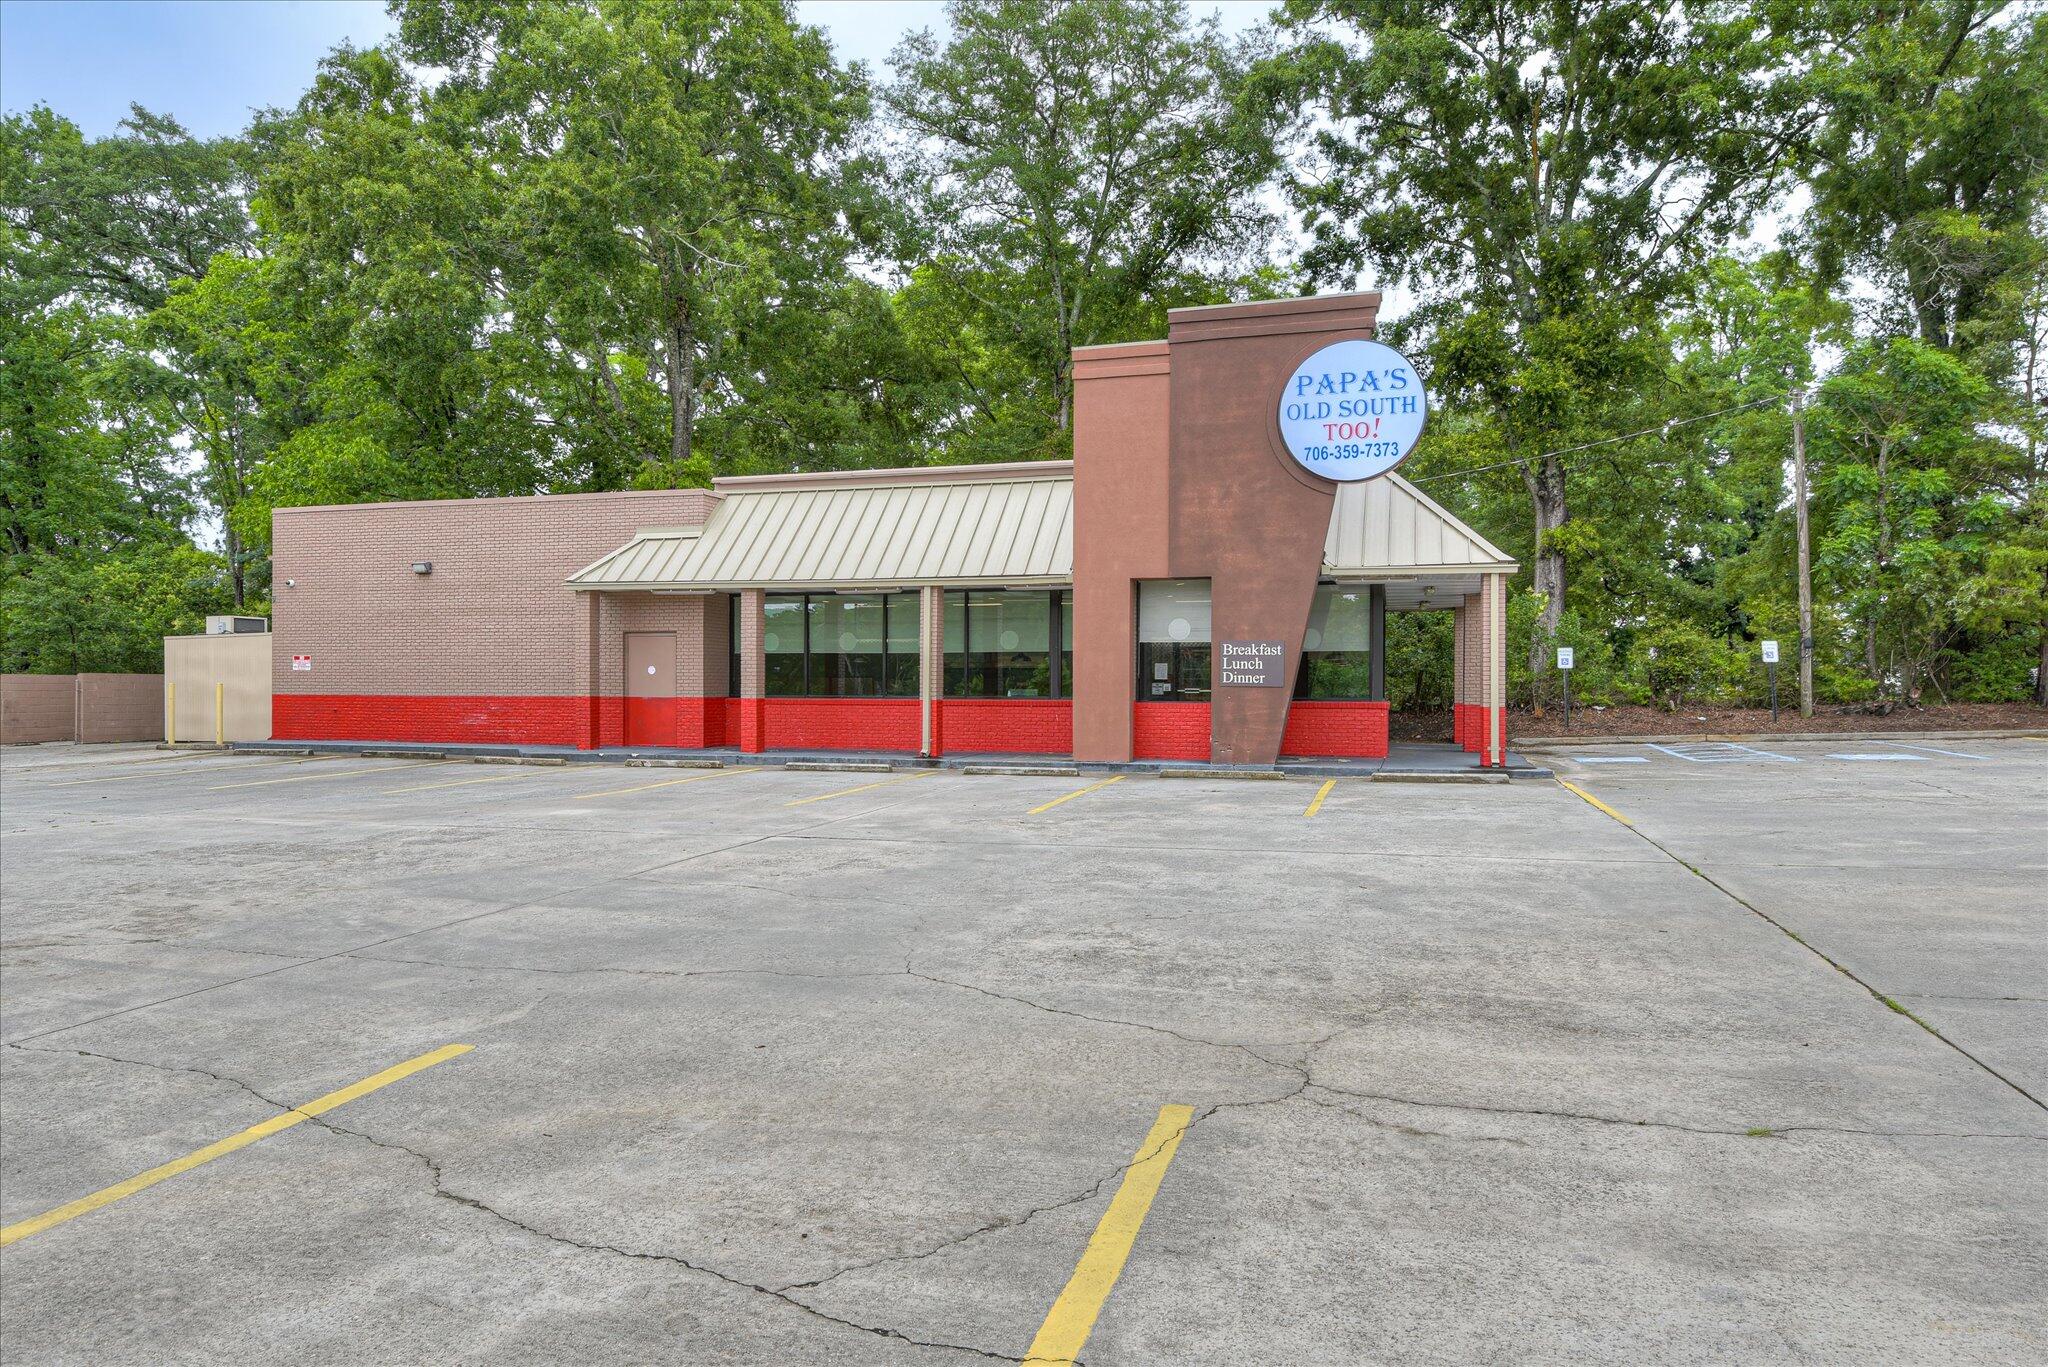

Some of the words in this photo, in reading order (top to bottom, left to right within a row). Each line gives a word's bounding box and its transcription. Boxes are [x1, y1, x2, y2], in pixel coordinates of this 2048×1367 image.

[1295, 368, 1408, 396] PAPA'S
[1287, 401, 1331, 421] OLD
[1338, 395, 1417, 418] SOUTH
[1323, 418, 1380, 441] TOO!
[1304, 442, 1399, 461] 706-359-7373
[1222, 643, 1282, 656] Breakfast
[1222, 657, 1263, 670] Lunch
[1222, 671, 1266, 684] Dinner
